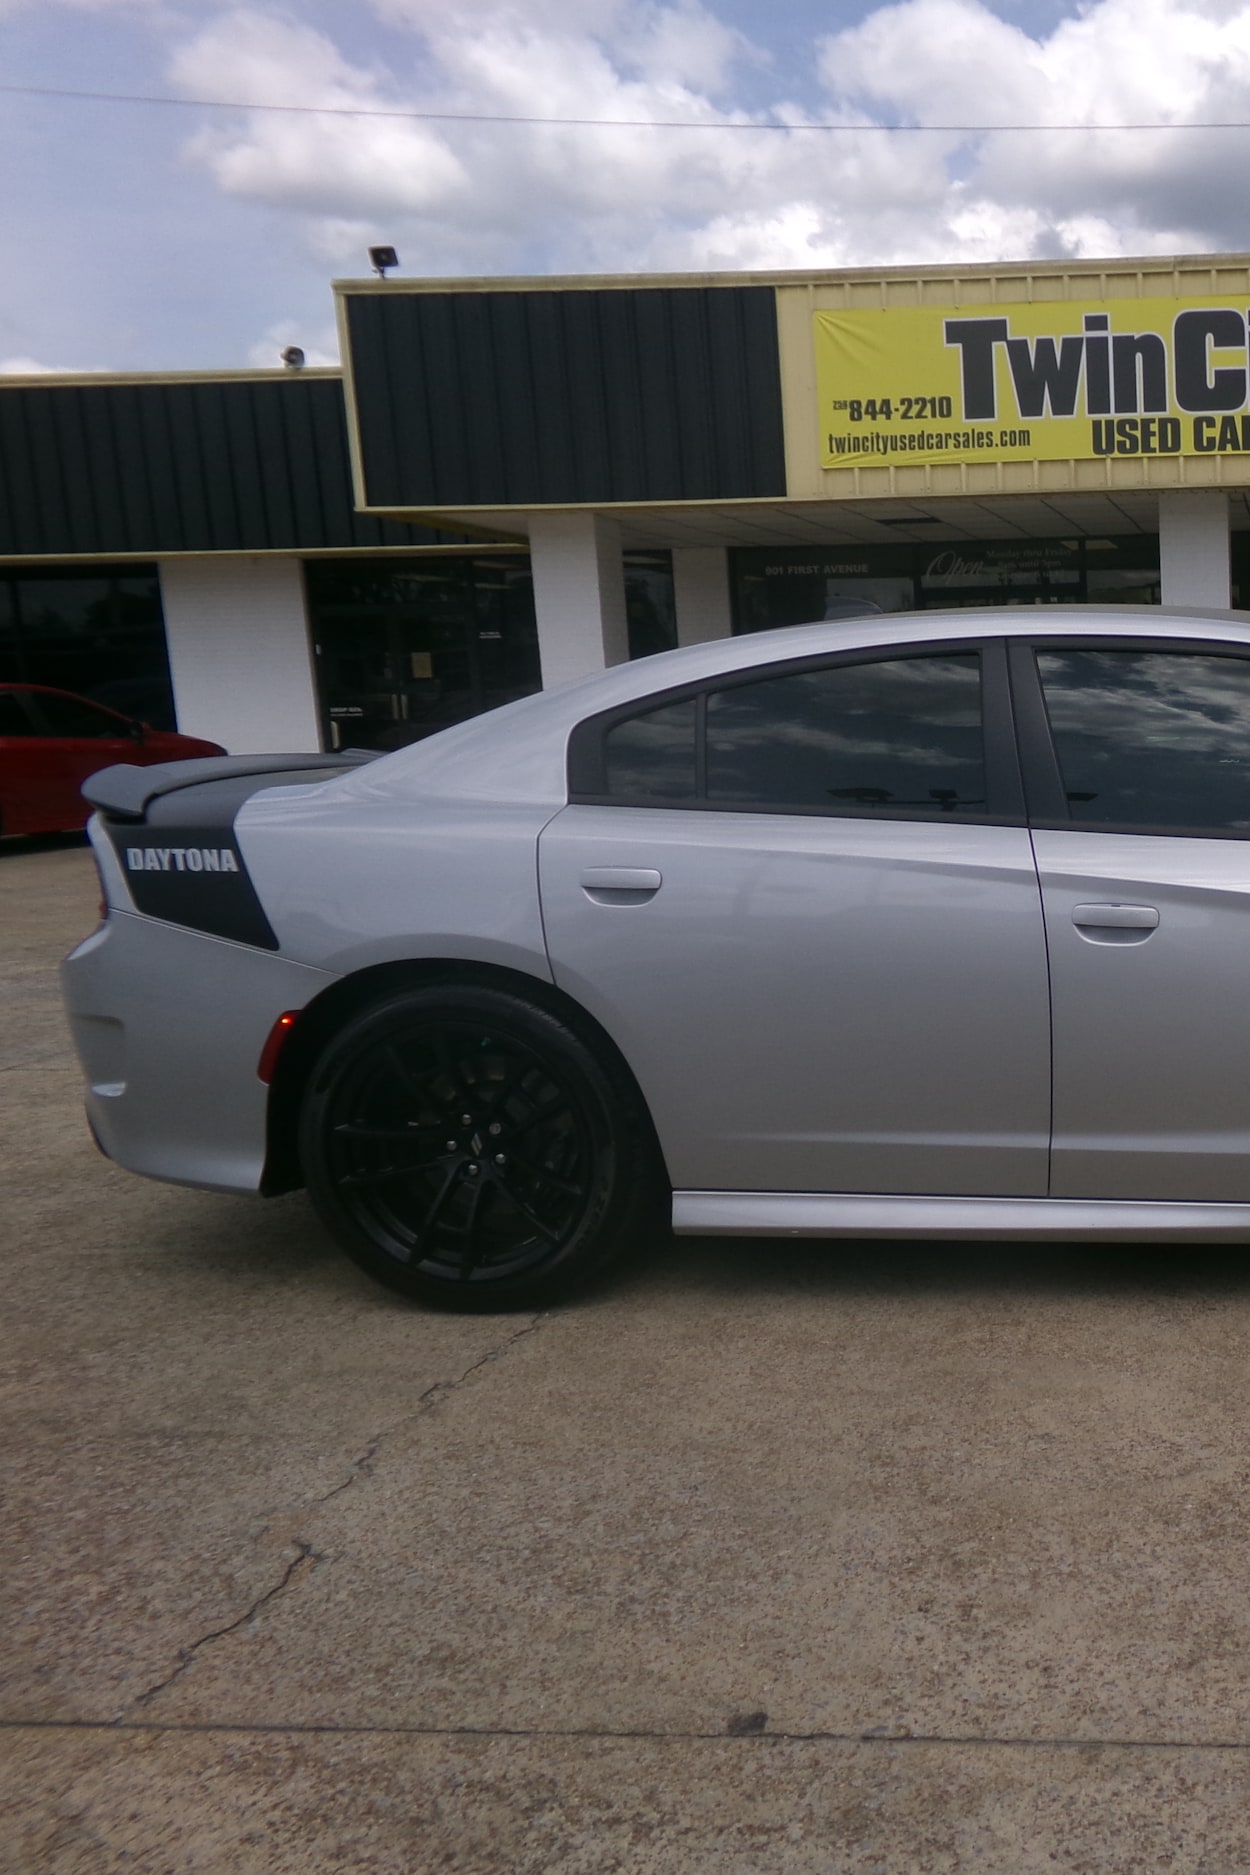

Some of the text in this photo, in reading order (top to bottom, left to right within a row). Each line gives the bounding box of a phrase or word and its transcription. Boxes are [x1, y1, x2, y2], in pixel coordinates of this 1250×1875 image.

[849, 396, 952, 422] 844-2210
[828, 428, 1031, 455] twincityusedcarsales.com
[1092, 417, 1181, 455] USED
[787, 564, 819, 575] FIRST
[823, 563, 869, 575] AVENUE
[926, 550, 984, 586] Open
[126, 848, 240, 872] DAYTONA
